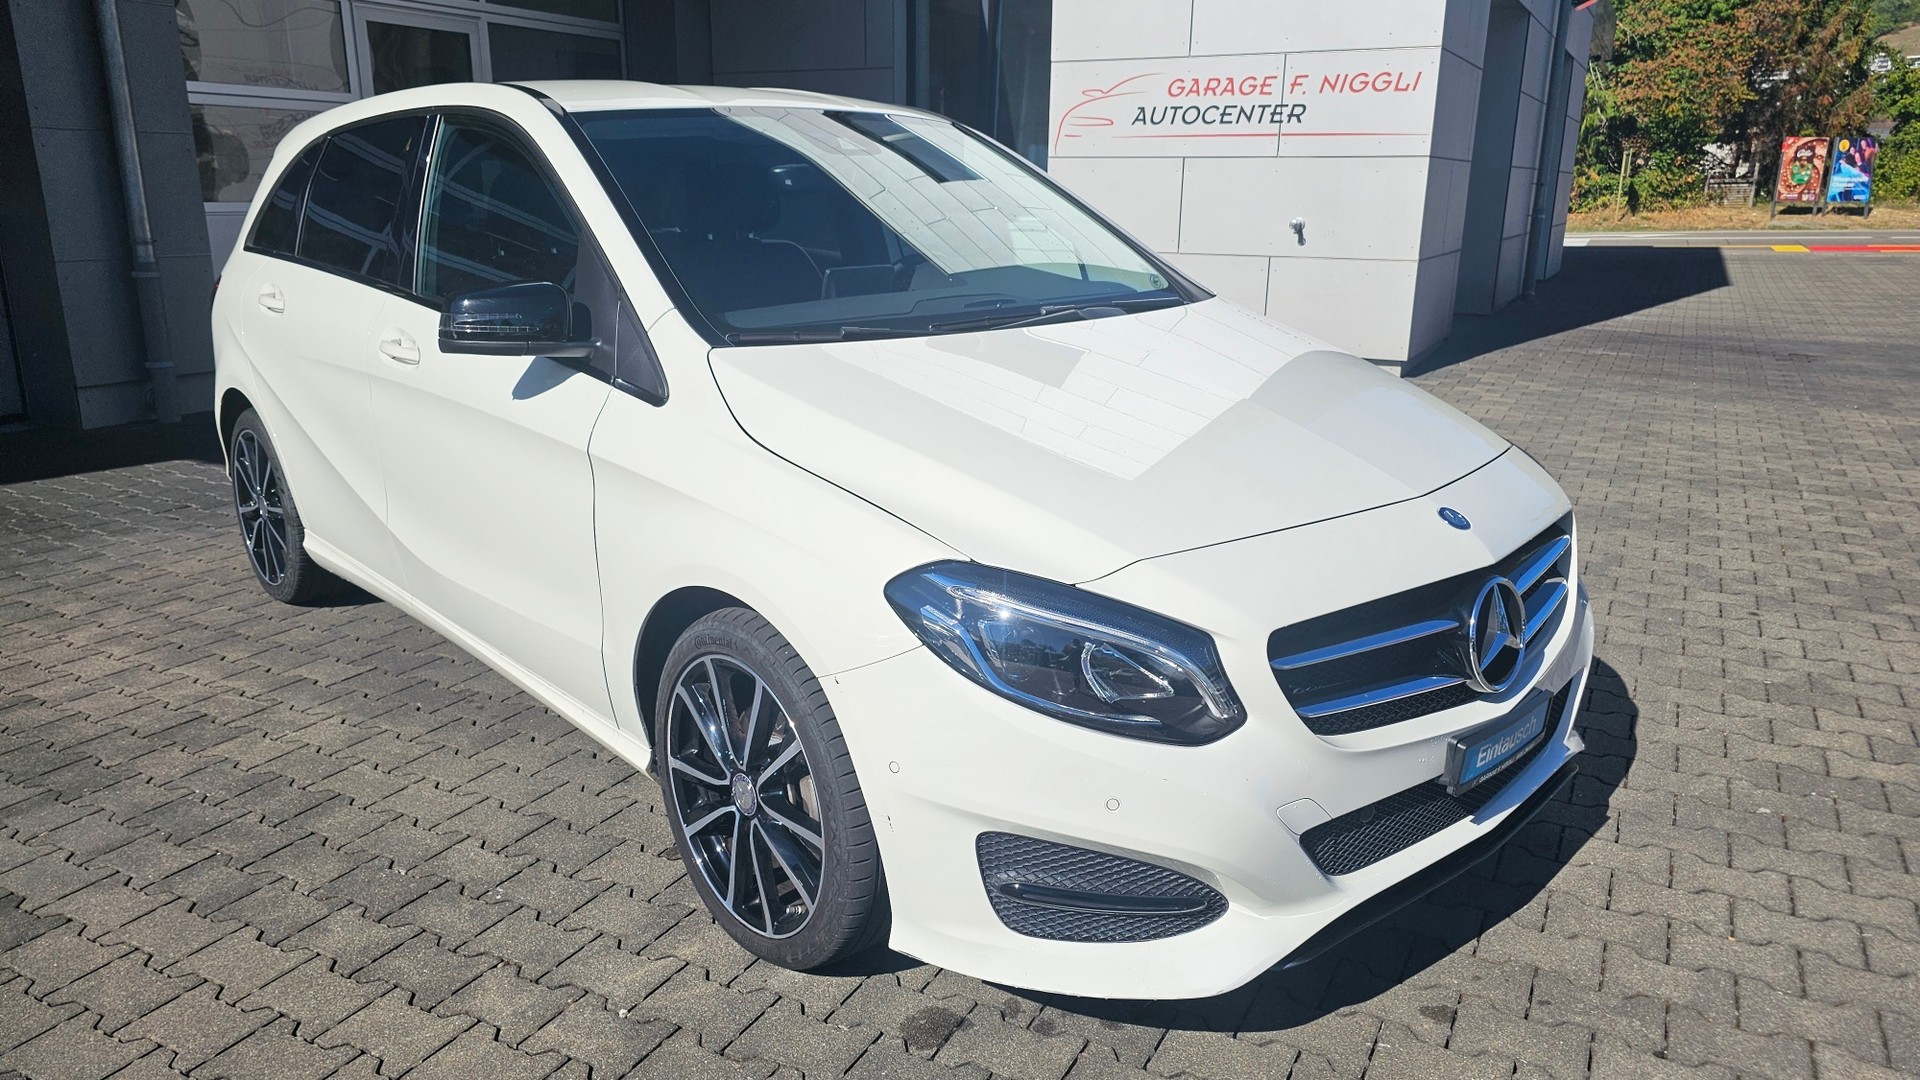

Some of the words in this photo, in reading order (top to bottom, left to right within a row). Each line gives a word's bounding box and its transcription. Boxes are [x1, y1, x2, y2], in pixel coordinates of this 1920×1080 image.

[1167, 76, 1277, 98] GARAGE
[1289, 74, 1309, 95] F.
[1319, 71, 1422, 94] NIGGLI
[1131, 104, 1307, 126] AUTOCENTER
[1476, 716, 1537, 768] Eintausch
